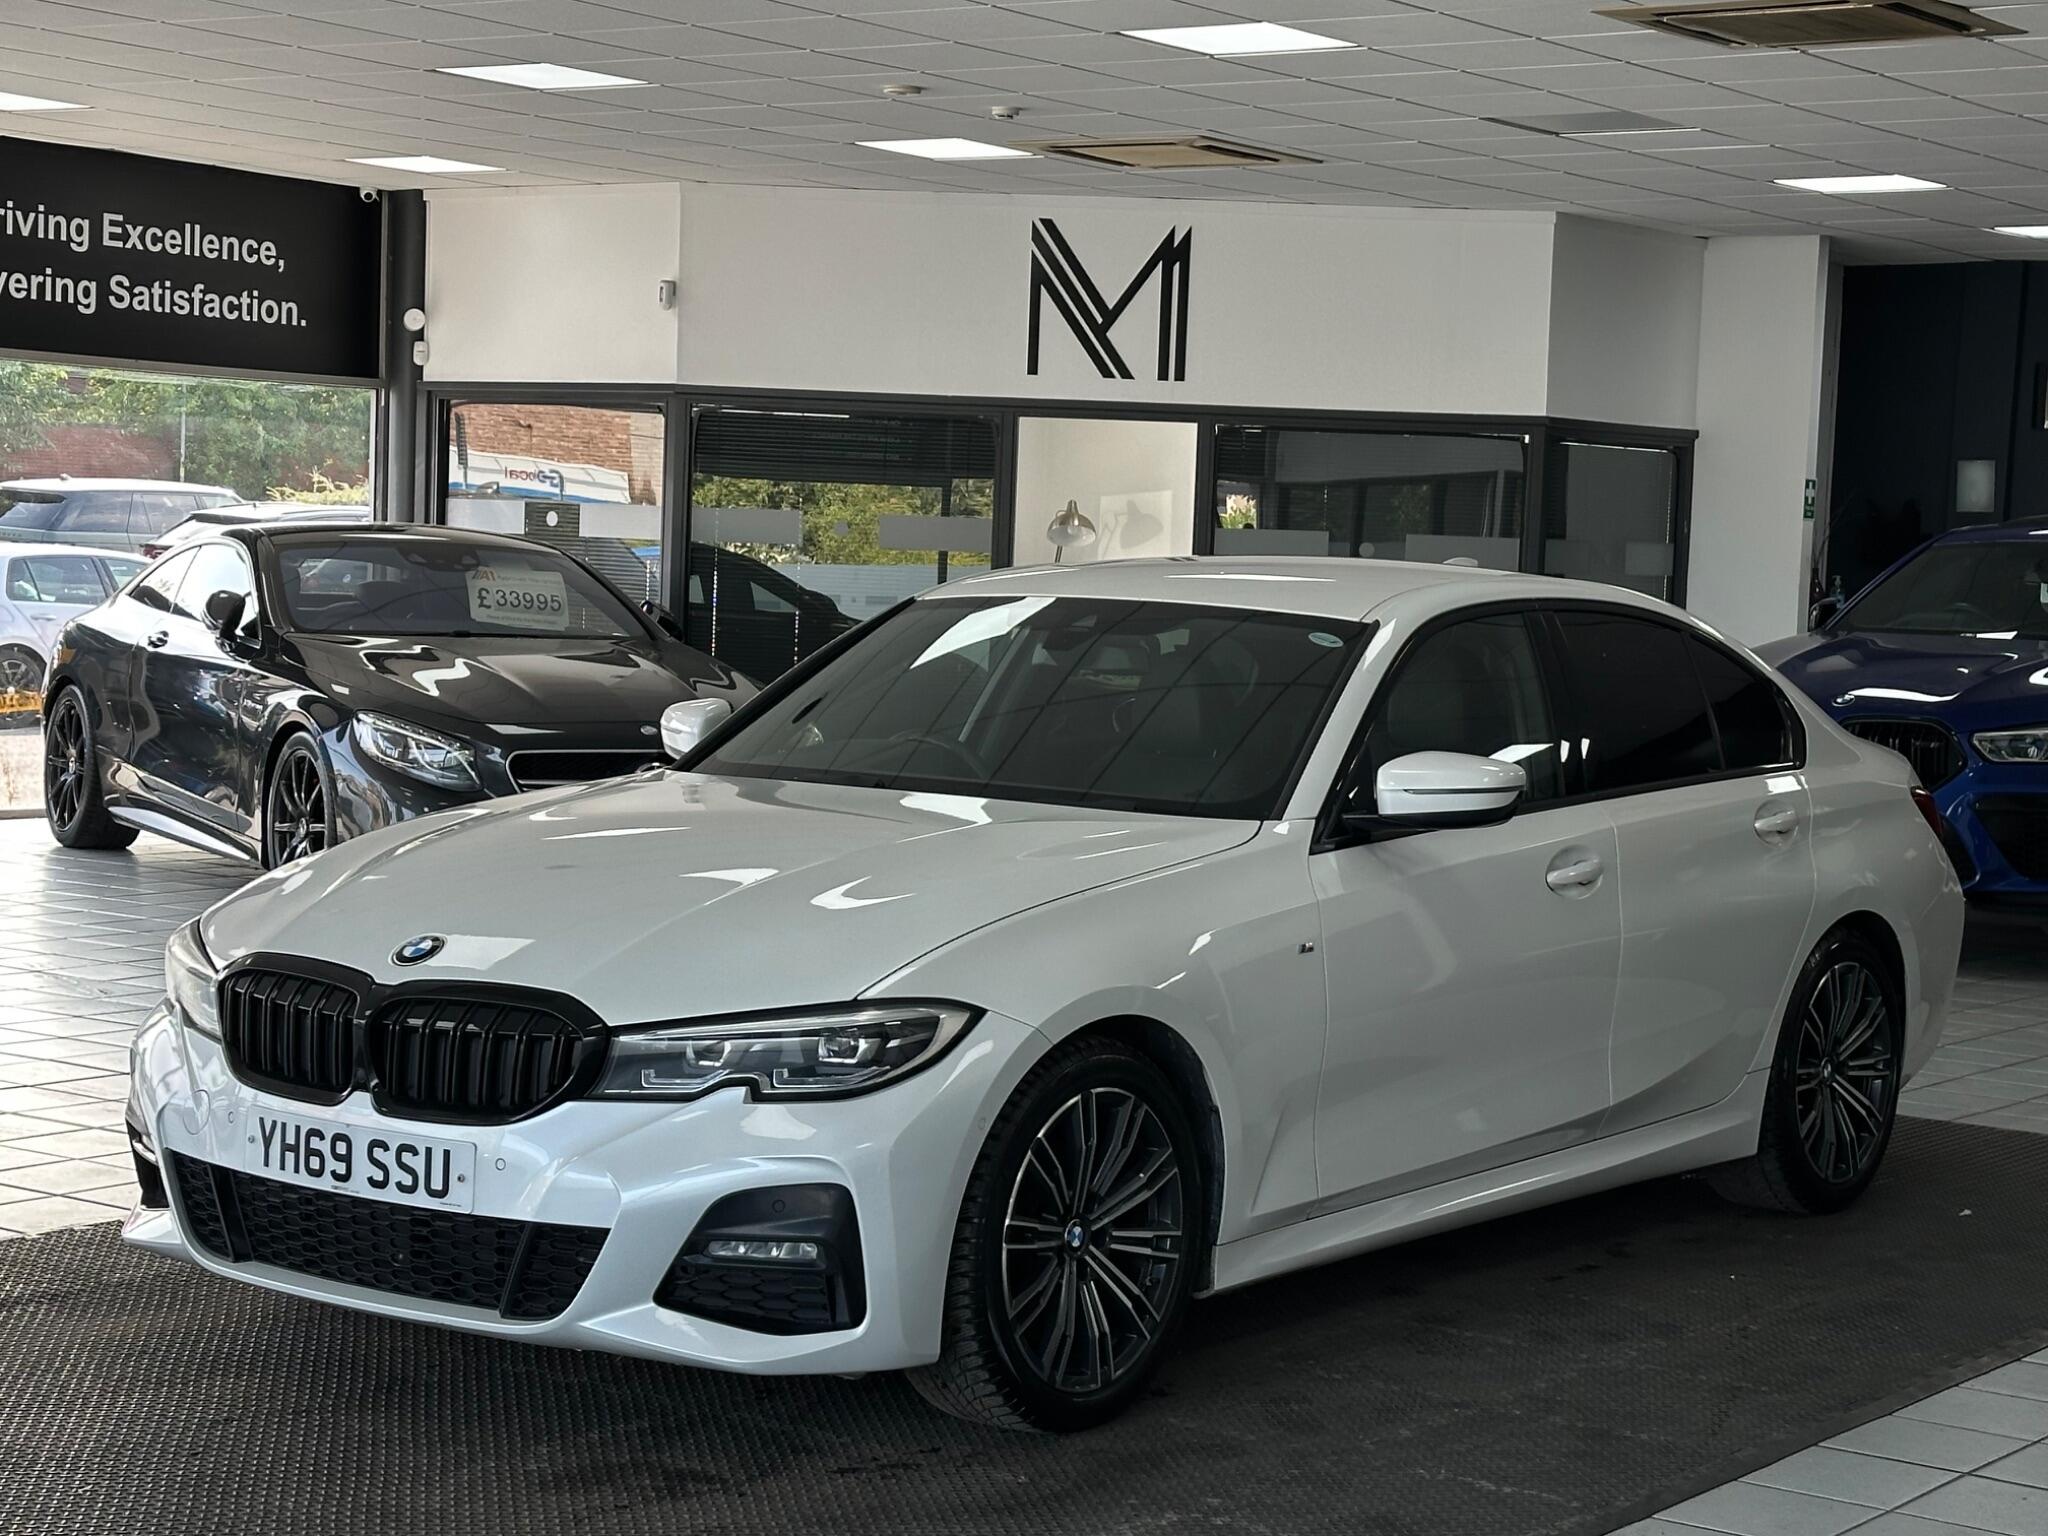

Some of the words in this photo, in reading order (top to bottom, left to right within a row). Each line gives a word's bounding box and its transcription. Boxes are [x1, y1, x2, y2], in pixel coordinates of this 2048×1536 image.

[102, 212, 285, 273] Excellence,
[108, 274, 307, 327] Satisfaction.
[477, 587, 562, 612] £33995
[258, 1116, 353, 1184] YH69
[366, 1138, 452, 1199] SSU
